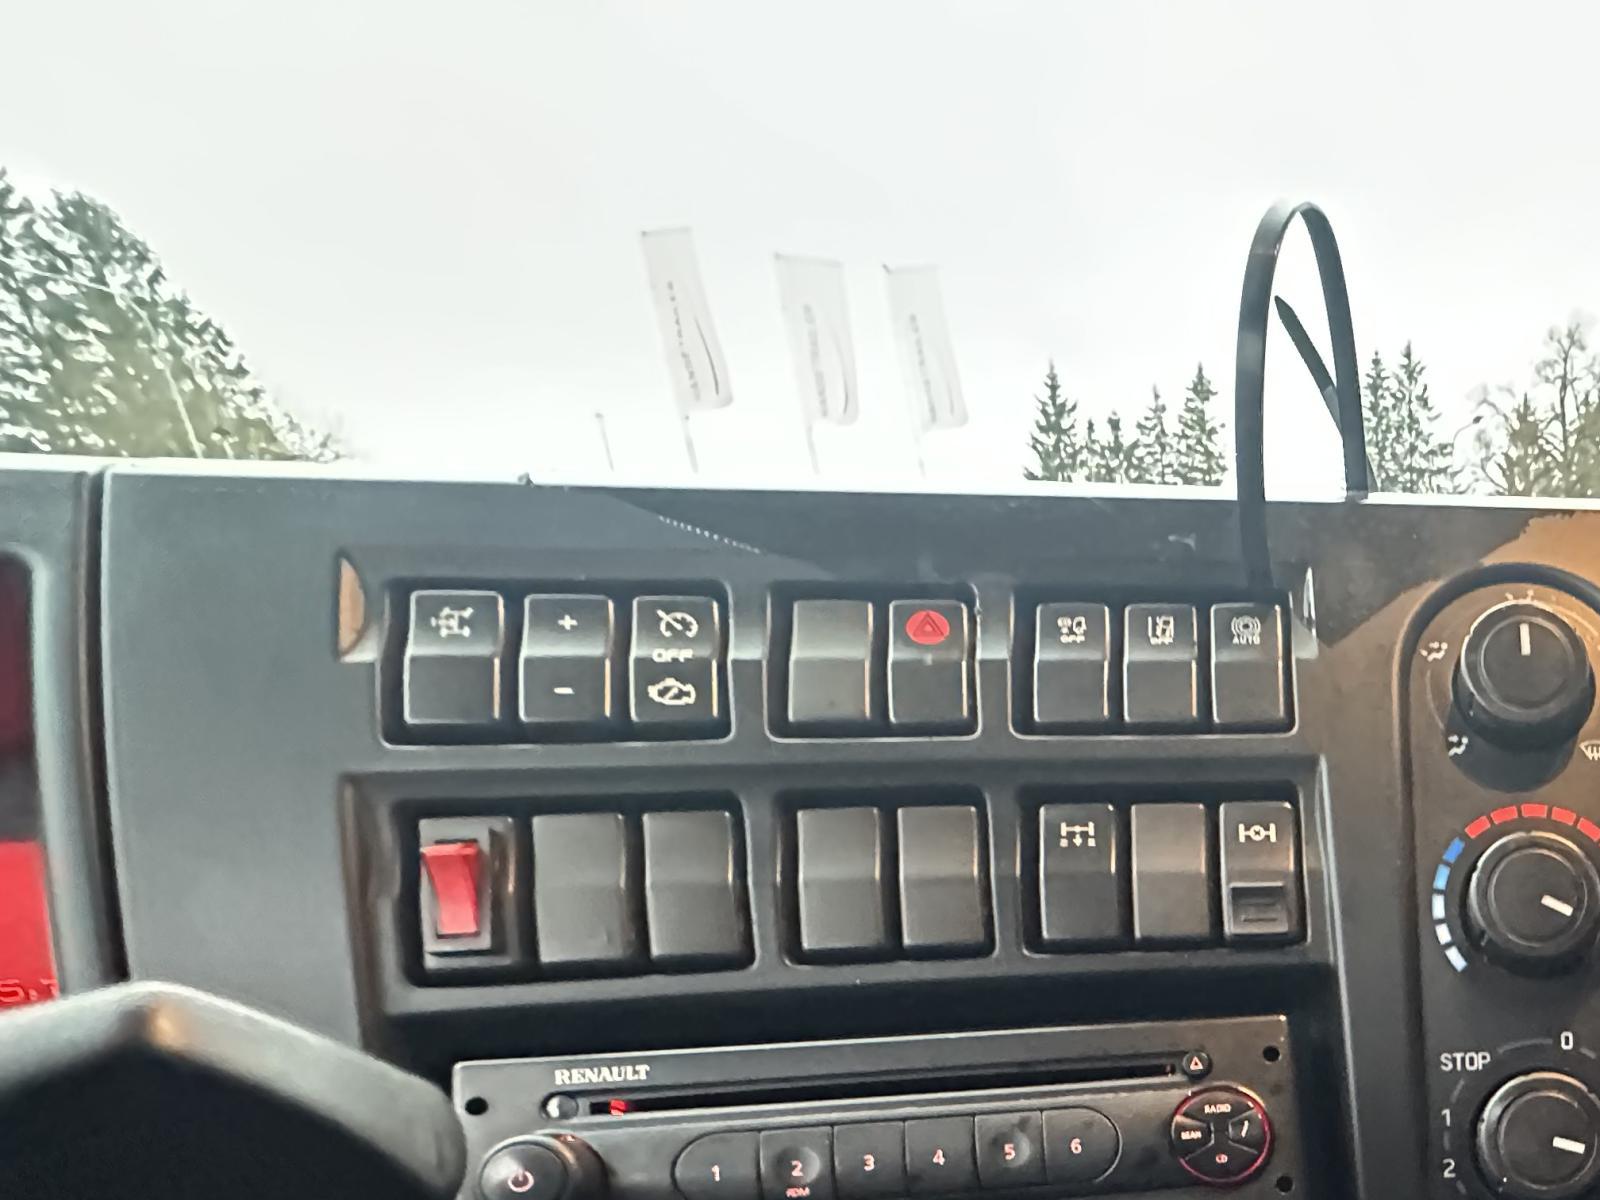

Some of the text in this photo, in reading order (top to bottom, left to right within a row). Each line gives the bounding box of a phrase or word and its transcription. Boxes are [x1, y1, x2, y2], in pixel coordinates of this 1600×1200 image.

[651, 648, 694, 664] OFF
[1560, 1031, 1574, 1051] 0
[1440, 1052, 1491, 1071] STOP
[554, 1064, 650, 1086] RENAULT
[1204, 1103, 1231, 1114] RADIO
[1441, 1109, 1451, 1126] 1
[1004, 1143, 1016, 1161] 5
[1070, 1138, 1082, 1154] 6
[864, 1154, 876, 1171] 3
[932, 1149, 945, 1166] 4
[711, 1164, 721, 1182] 1
[791, 1159, 804, 1177] 2
[1443, 1159, 1456, 1178] 2
